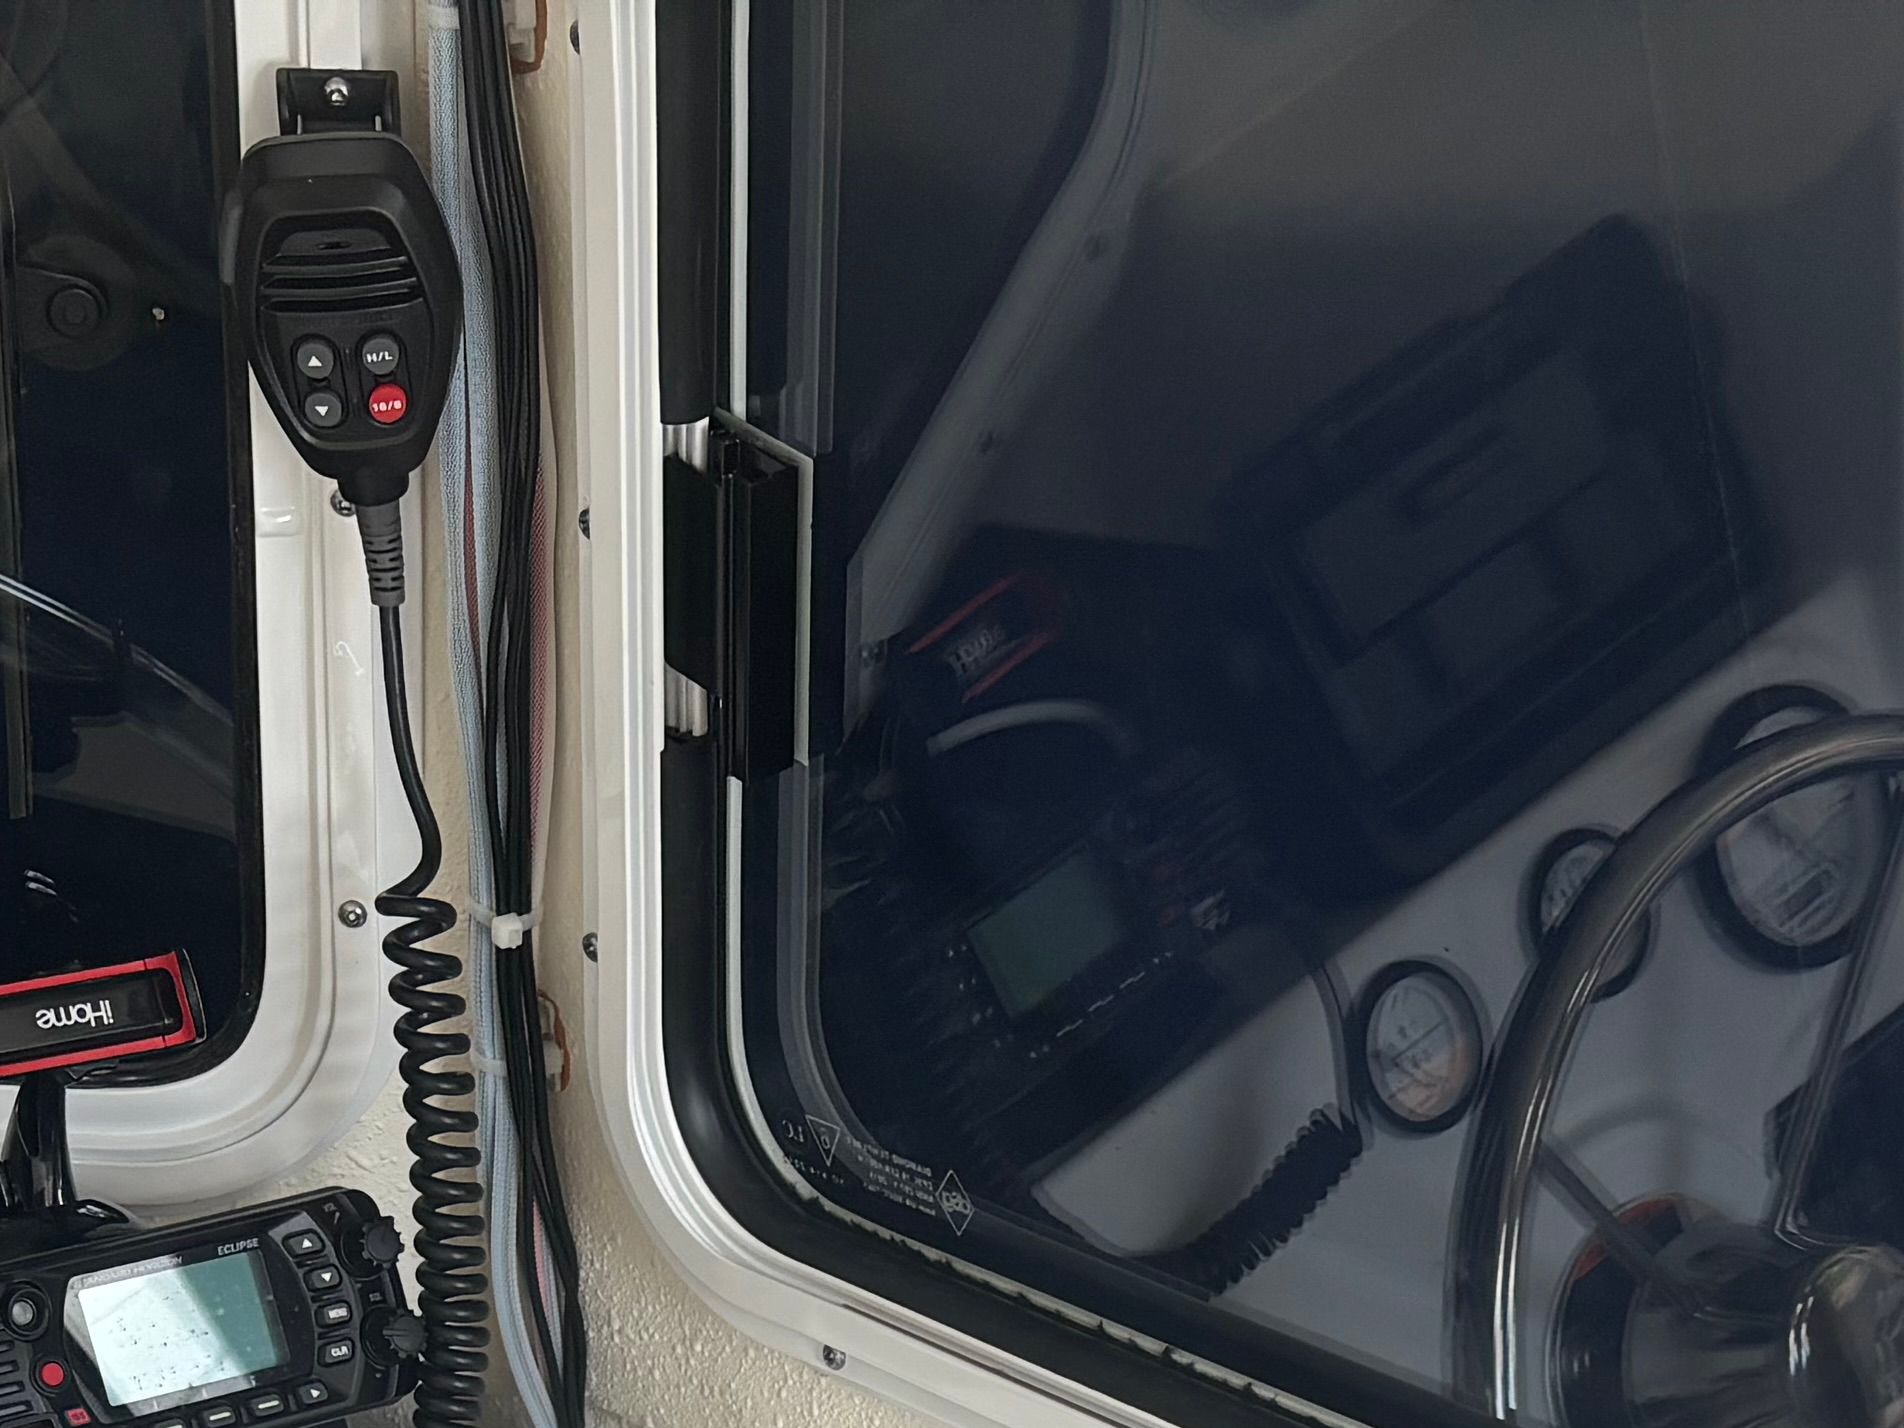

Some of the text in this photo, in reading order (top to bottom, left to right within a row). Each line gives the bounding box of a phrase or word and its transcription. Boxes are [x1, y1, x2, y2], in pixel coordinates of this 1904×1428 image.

[366, 350, 393, 363] H/L
[35, 1000, 114, 1029] iHome
[216, 1236, 260, 1256] ECLIPSE
